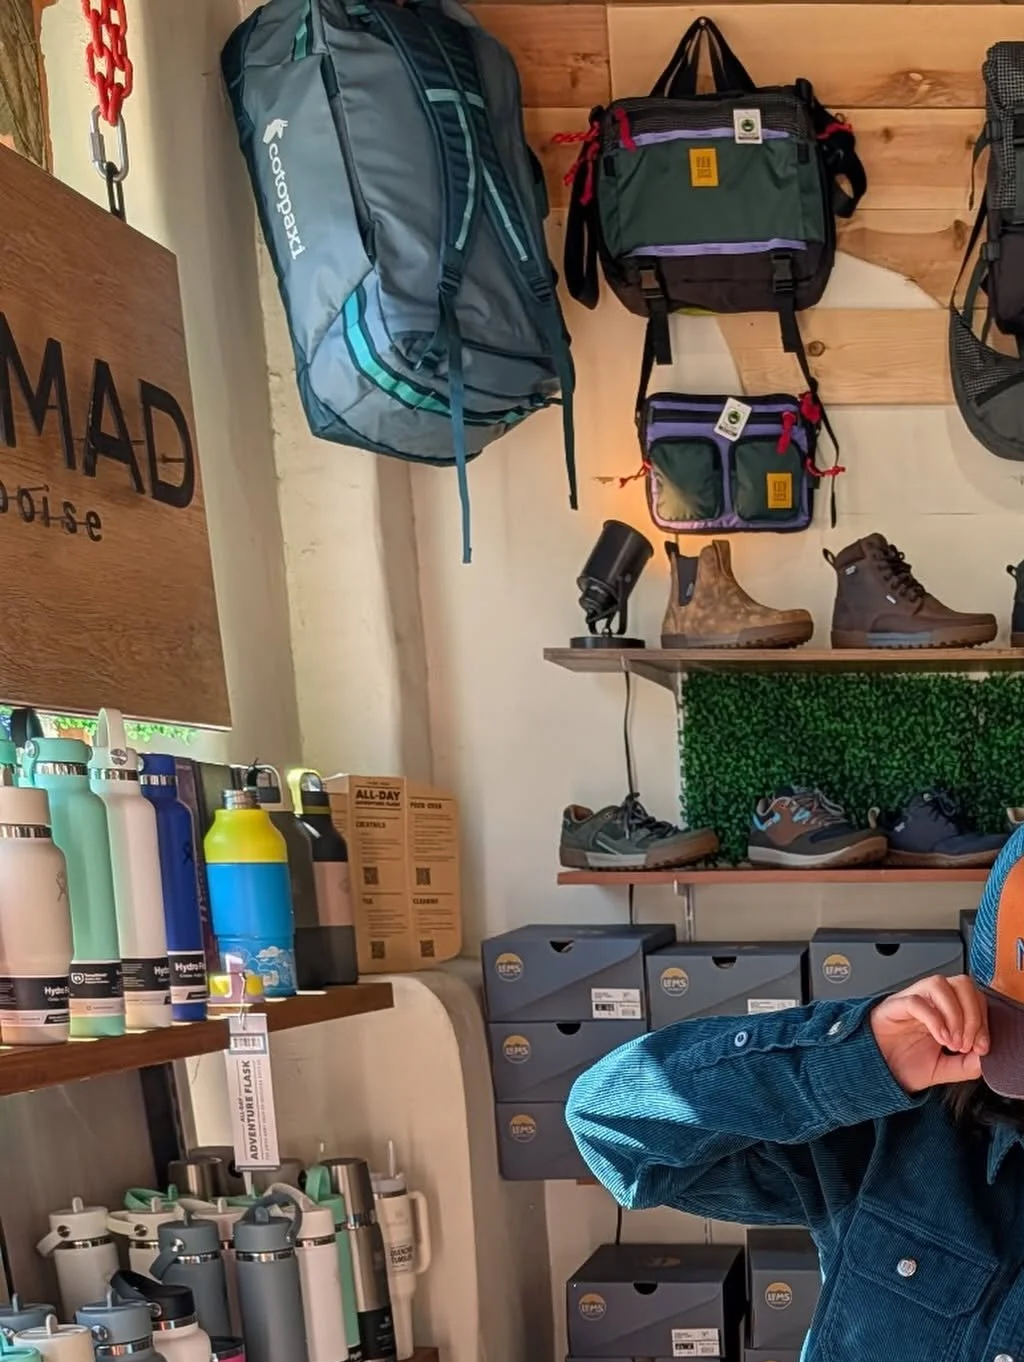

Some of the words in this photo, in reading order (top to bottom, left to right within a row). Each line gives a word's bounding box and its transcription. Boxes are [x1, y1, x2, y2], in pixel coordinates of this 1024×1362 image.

[269, 143, 306, 260] cotopaxi
[0, 311, 195, 509] MAD
[355, 789, 400, 801] ALL-DAY
[241, 1060, 252, 1093] FLASK
[245, 1096, 259, 1160] ADVENTURE
